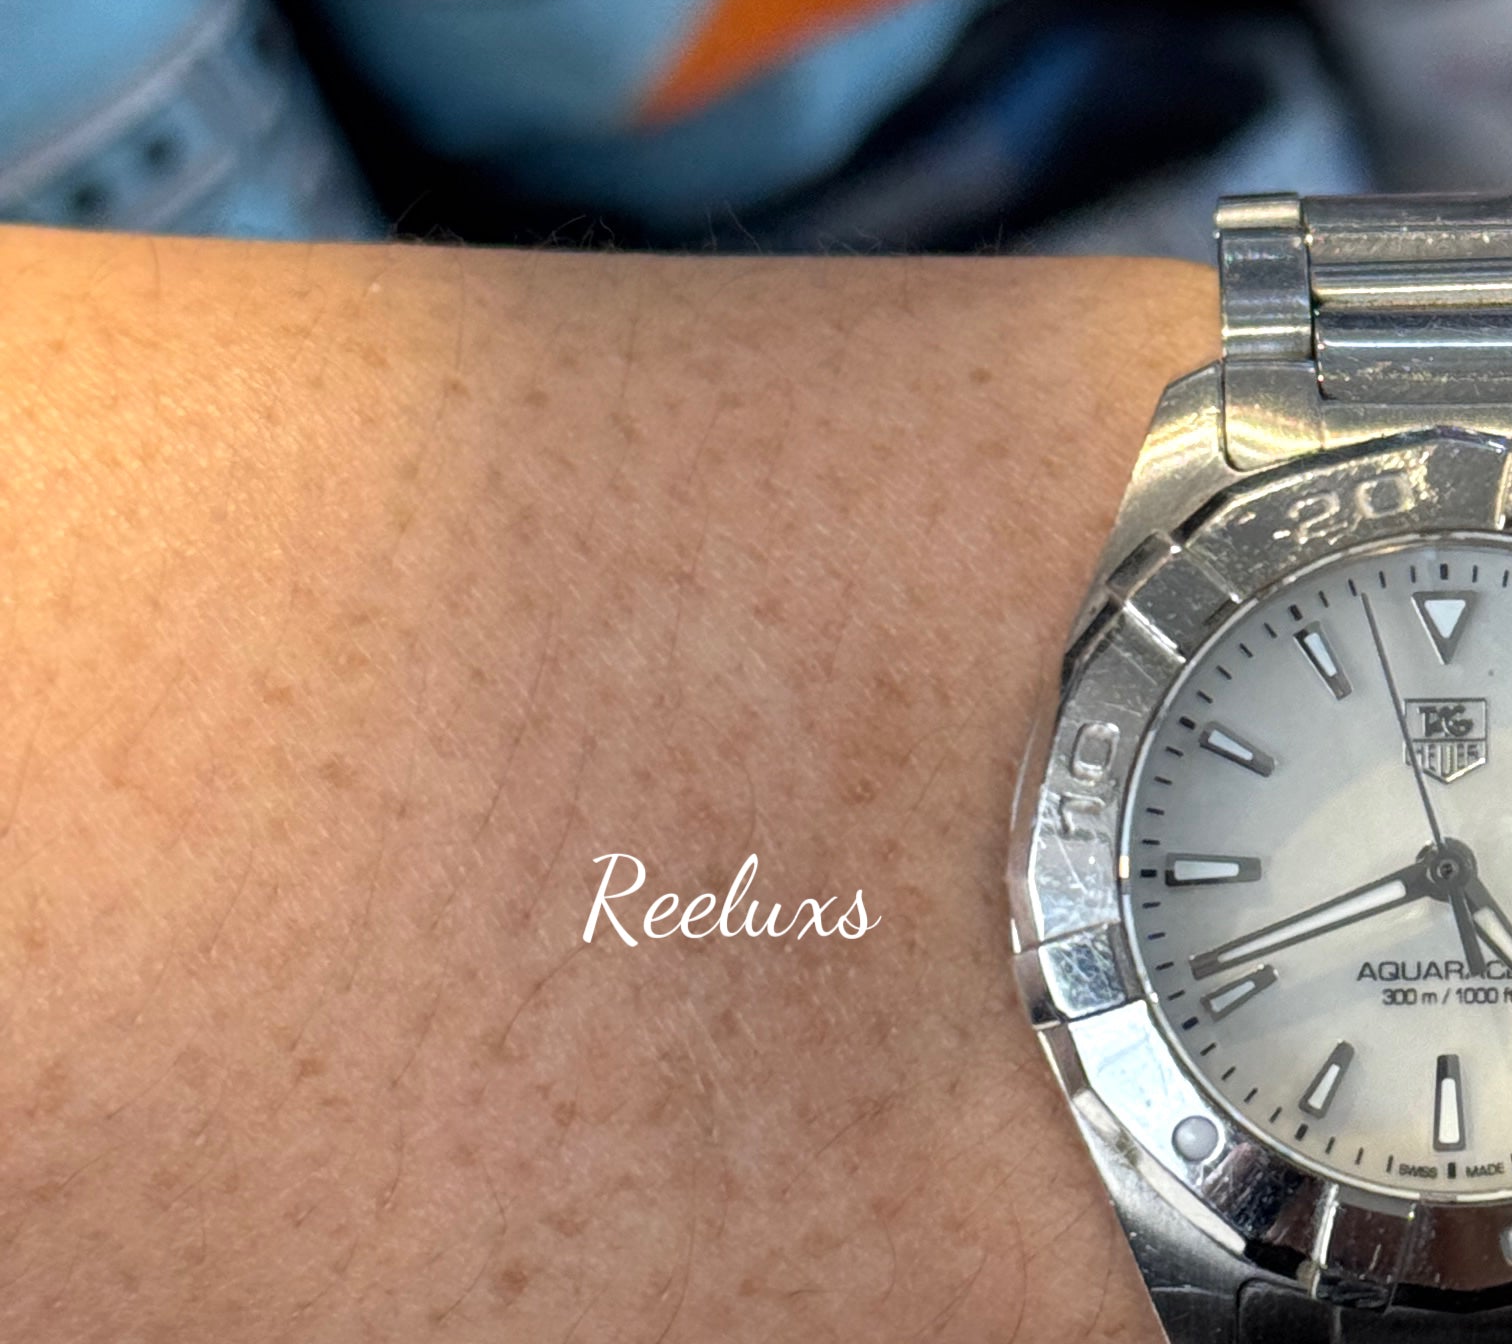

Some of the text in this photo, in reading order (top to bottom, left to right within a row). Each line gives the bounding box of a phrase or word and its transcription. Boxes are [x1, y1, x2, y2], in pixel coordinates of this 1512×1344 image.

[1418, 705, 1474, 737] TAG
[1382, 987, 1418, 1006] 300
[1421, 990, 1438, 1005] m
[1455, 986, 1498, 1005] 1000
[1398, 1161, 1505, 1179] SWISS MADE
